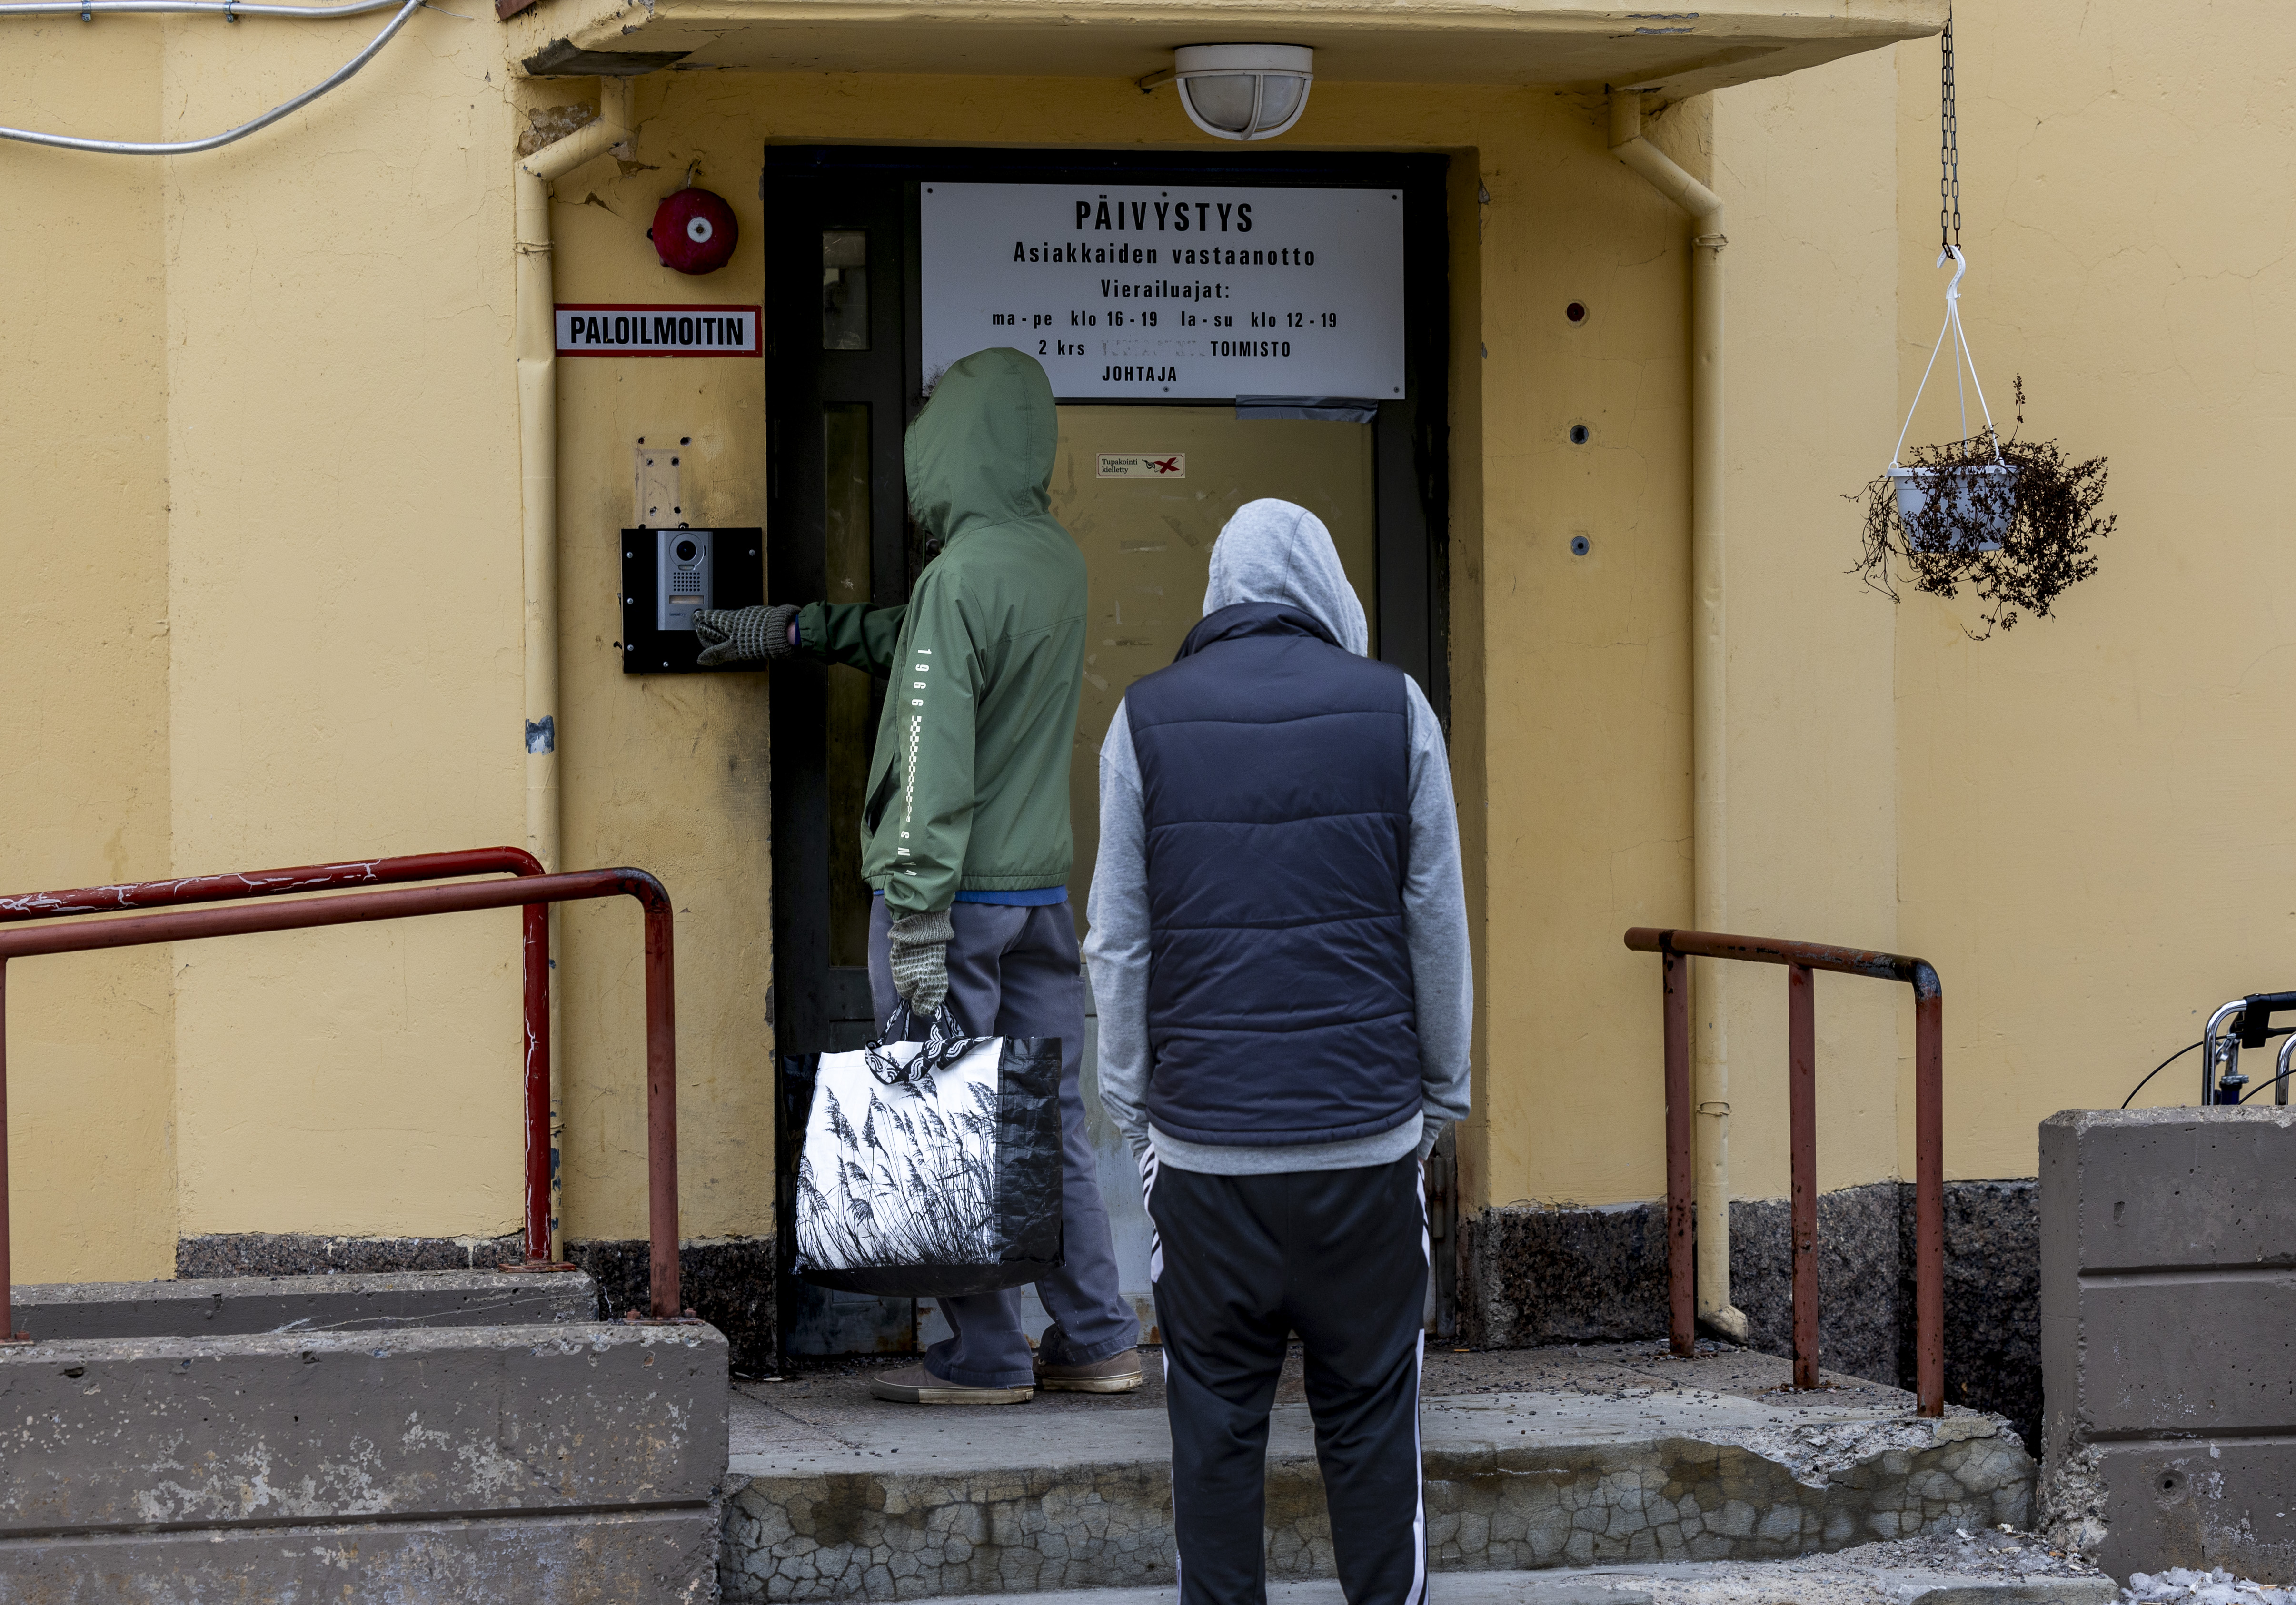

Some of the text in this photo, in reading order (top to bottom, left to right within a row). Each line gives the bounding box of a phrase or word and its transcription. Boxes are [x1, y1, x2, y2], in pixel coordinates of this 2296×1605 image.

[1076, 194, 1252, 232] PÄIVYSTYS
[1013, 241, 1315, 266] Asiakkaiden vastaanotto
[1101, 279, 1229, 303] Vierailuajat:
[571, 316, 743, 345] PALOILMOITIN
[1071, 310, 1096, 327] klo
[1251, 311, 1276, 327] klo
[1038, 339, 1047, 355] 2
[1057, 339, 1085, 356] krs
[1210, 340, 1291, 357] TOIMISTO
[1102, 366, 1177, 382] JOHTAJA
[1102, 466, 1129, 474] kielletty
[911, 649, 932, 706] 1966
